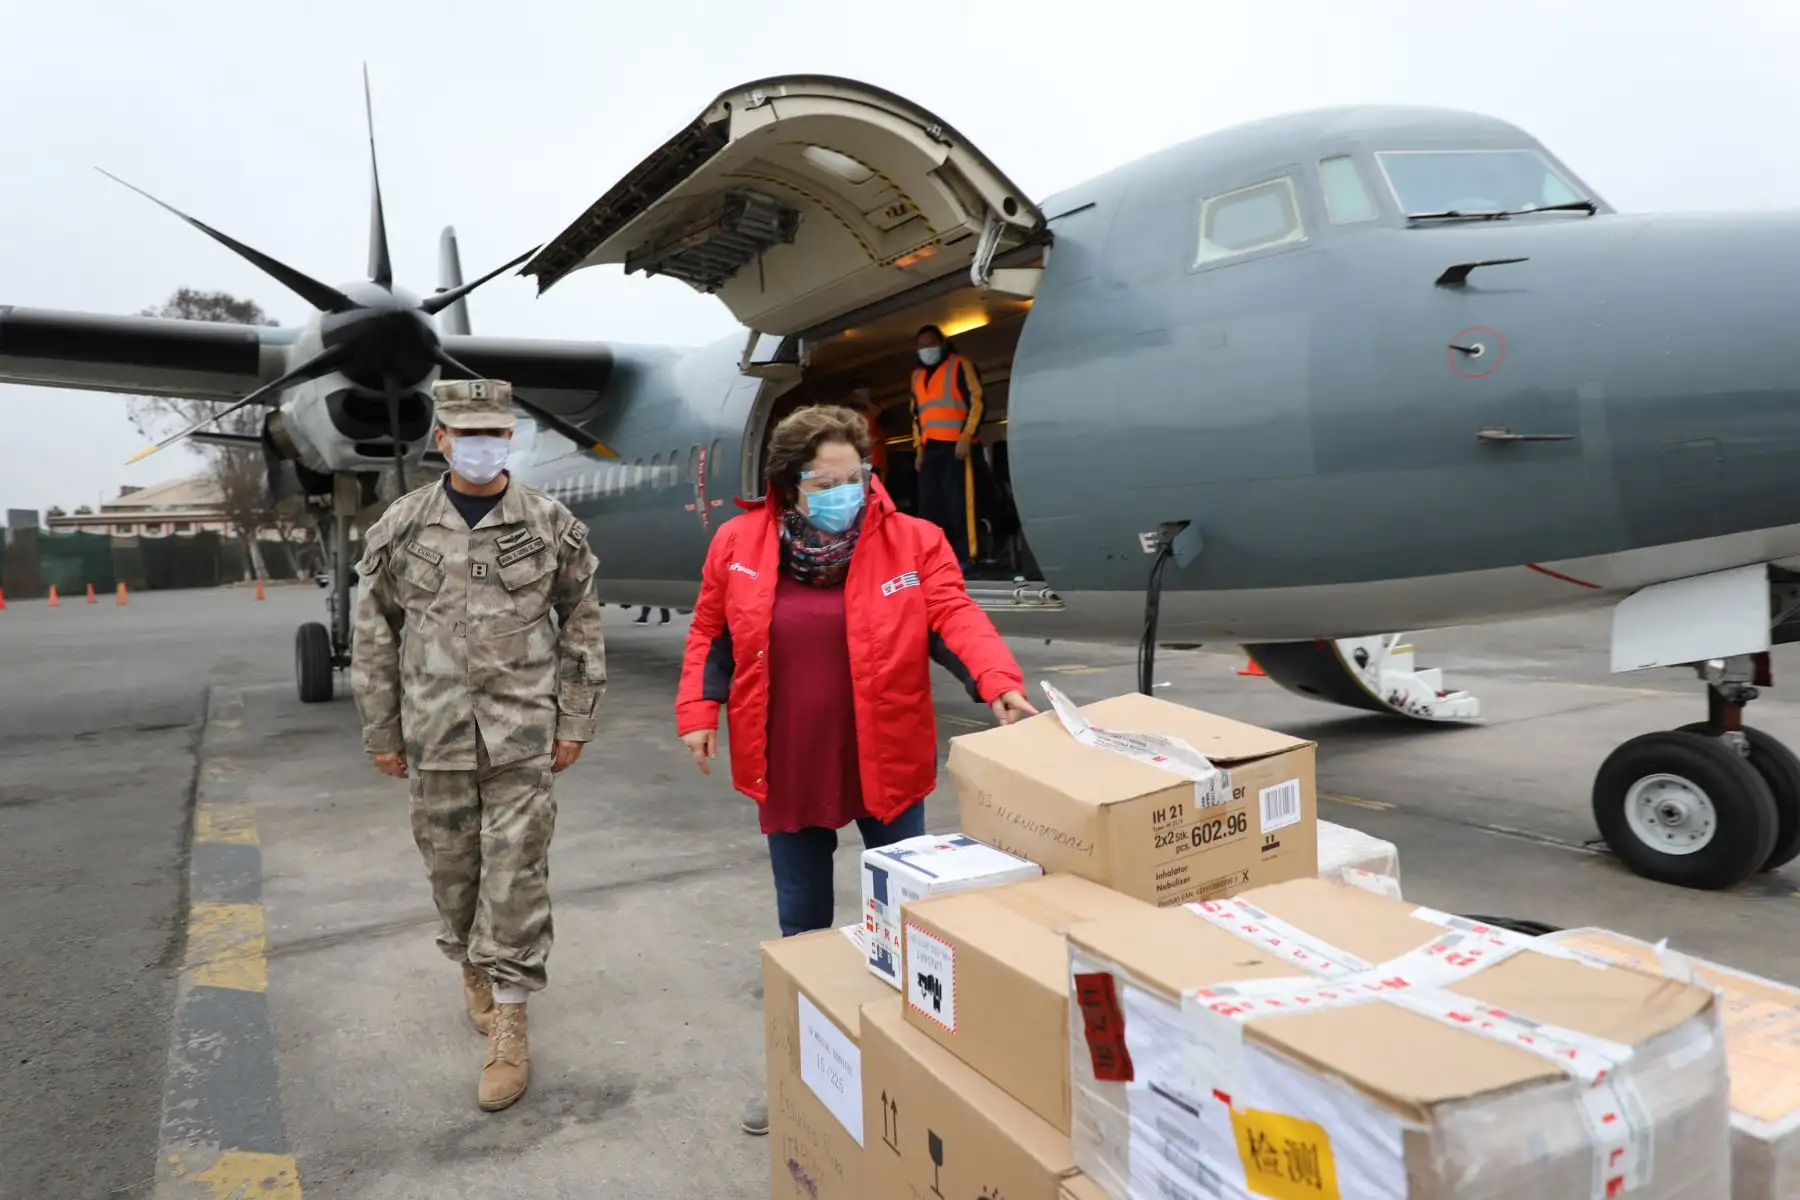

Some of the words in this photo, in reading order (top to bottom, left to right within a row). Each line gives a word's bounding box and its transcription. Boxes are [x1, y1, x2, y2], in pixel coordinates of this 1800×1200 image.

[1152, 809, 1166, 825] IH
[1170, 804, 1183, 819] 21
[1154, 831, 1175, 848] 2x2
[1191, 812, 1247, 848] 602.96
[1156, 865, 1188, 881] Inhalator
[1156, 876, 1191, 893] Nebulizer
